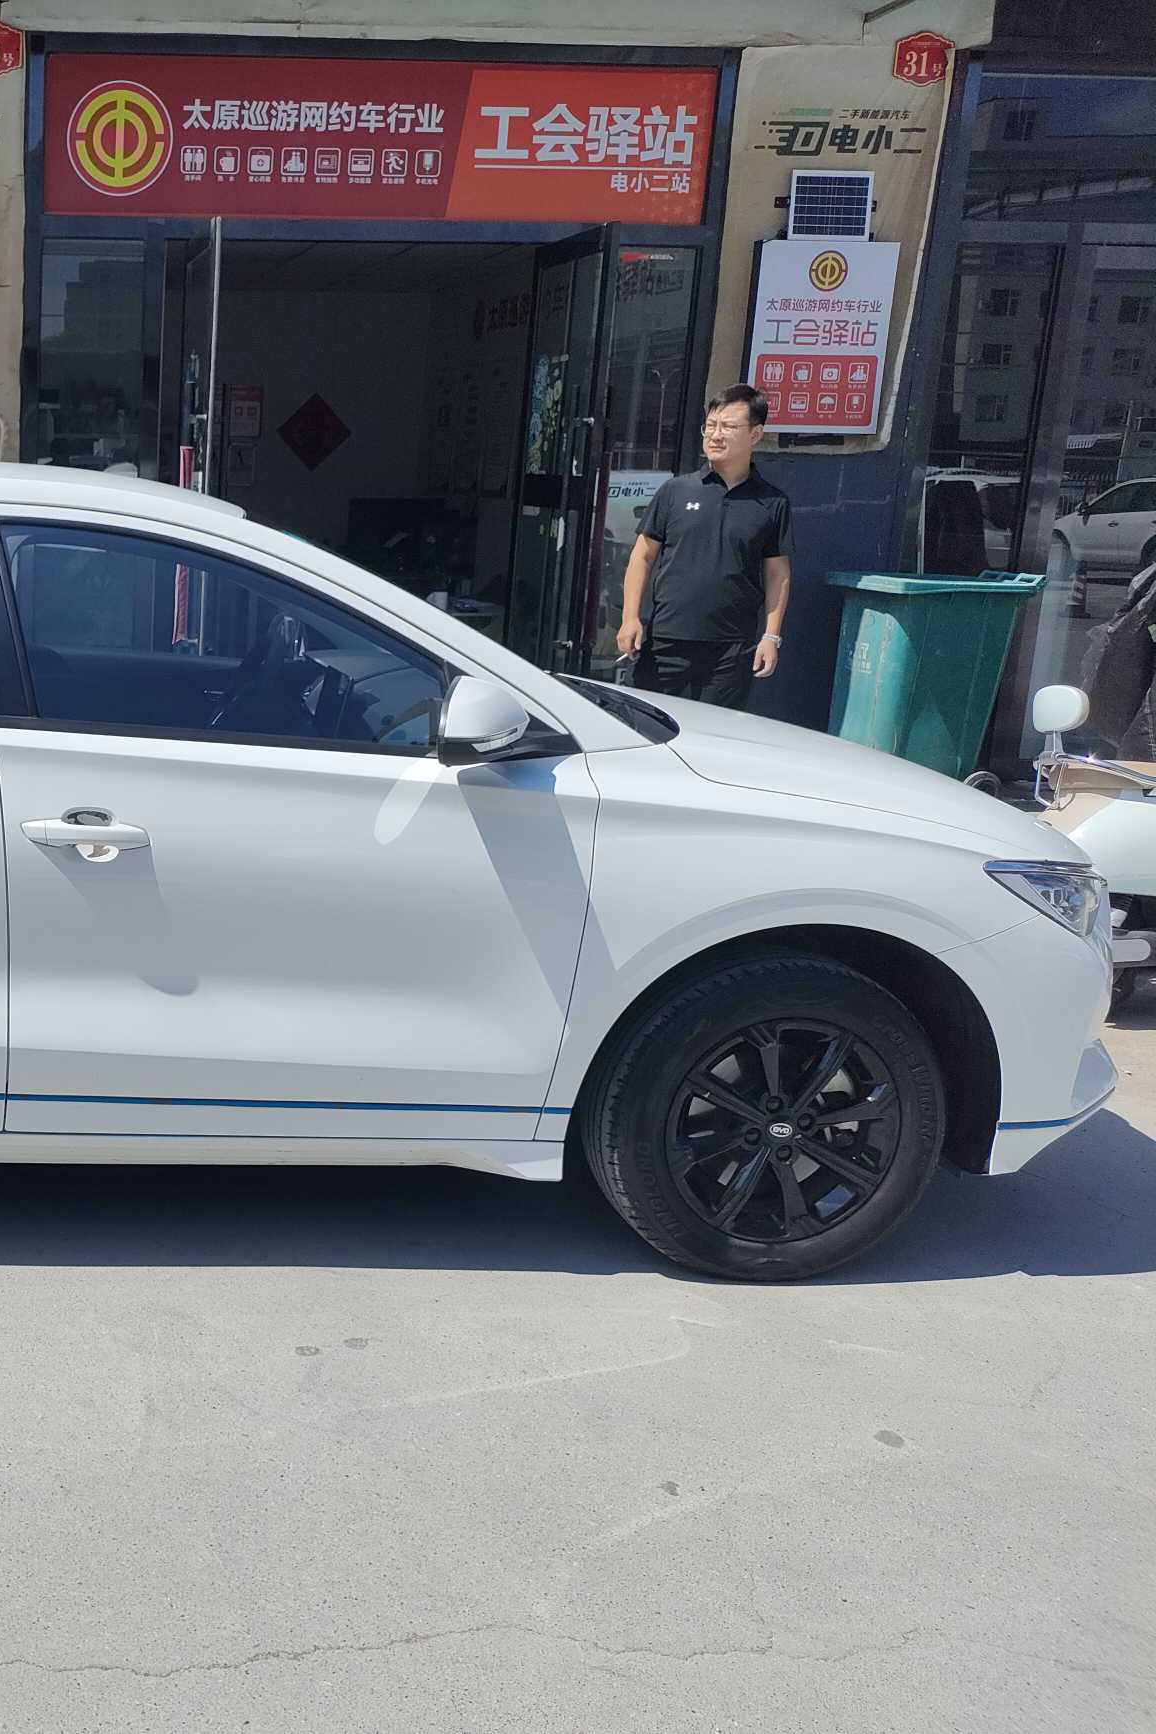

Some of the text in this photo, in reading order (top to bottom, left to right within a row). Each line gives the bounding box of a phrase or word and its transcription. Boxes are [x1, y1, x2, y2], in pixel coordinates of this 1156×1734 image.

[903, 50, 943, 77] 31号
[182, 98, 444, 134] 太原巡游网约车行业
[474, 103, 698, 165] 工会驿站
[827, 124, 927, 155] 电小二
[610, 173, 690, 194] 电小二站
[766, 298, 883, 313] 太原巡游网约车行业
[763, 319, 879, 346] 工会驿站
